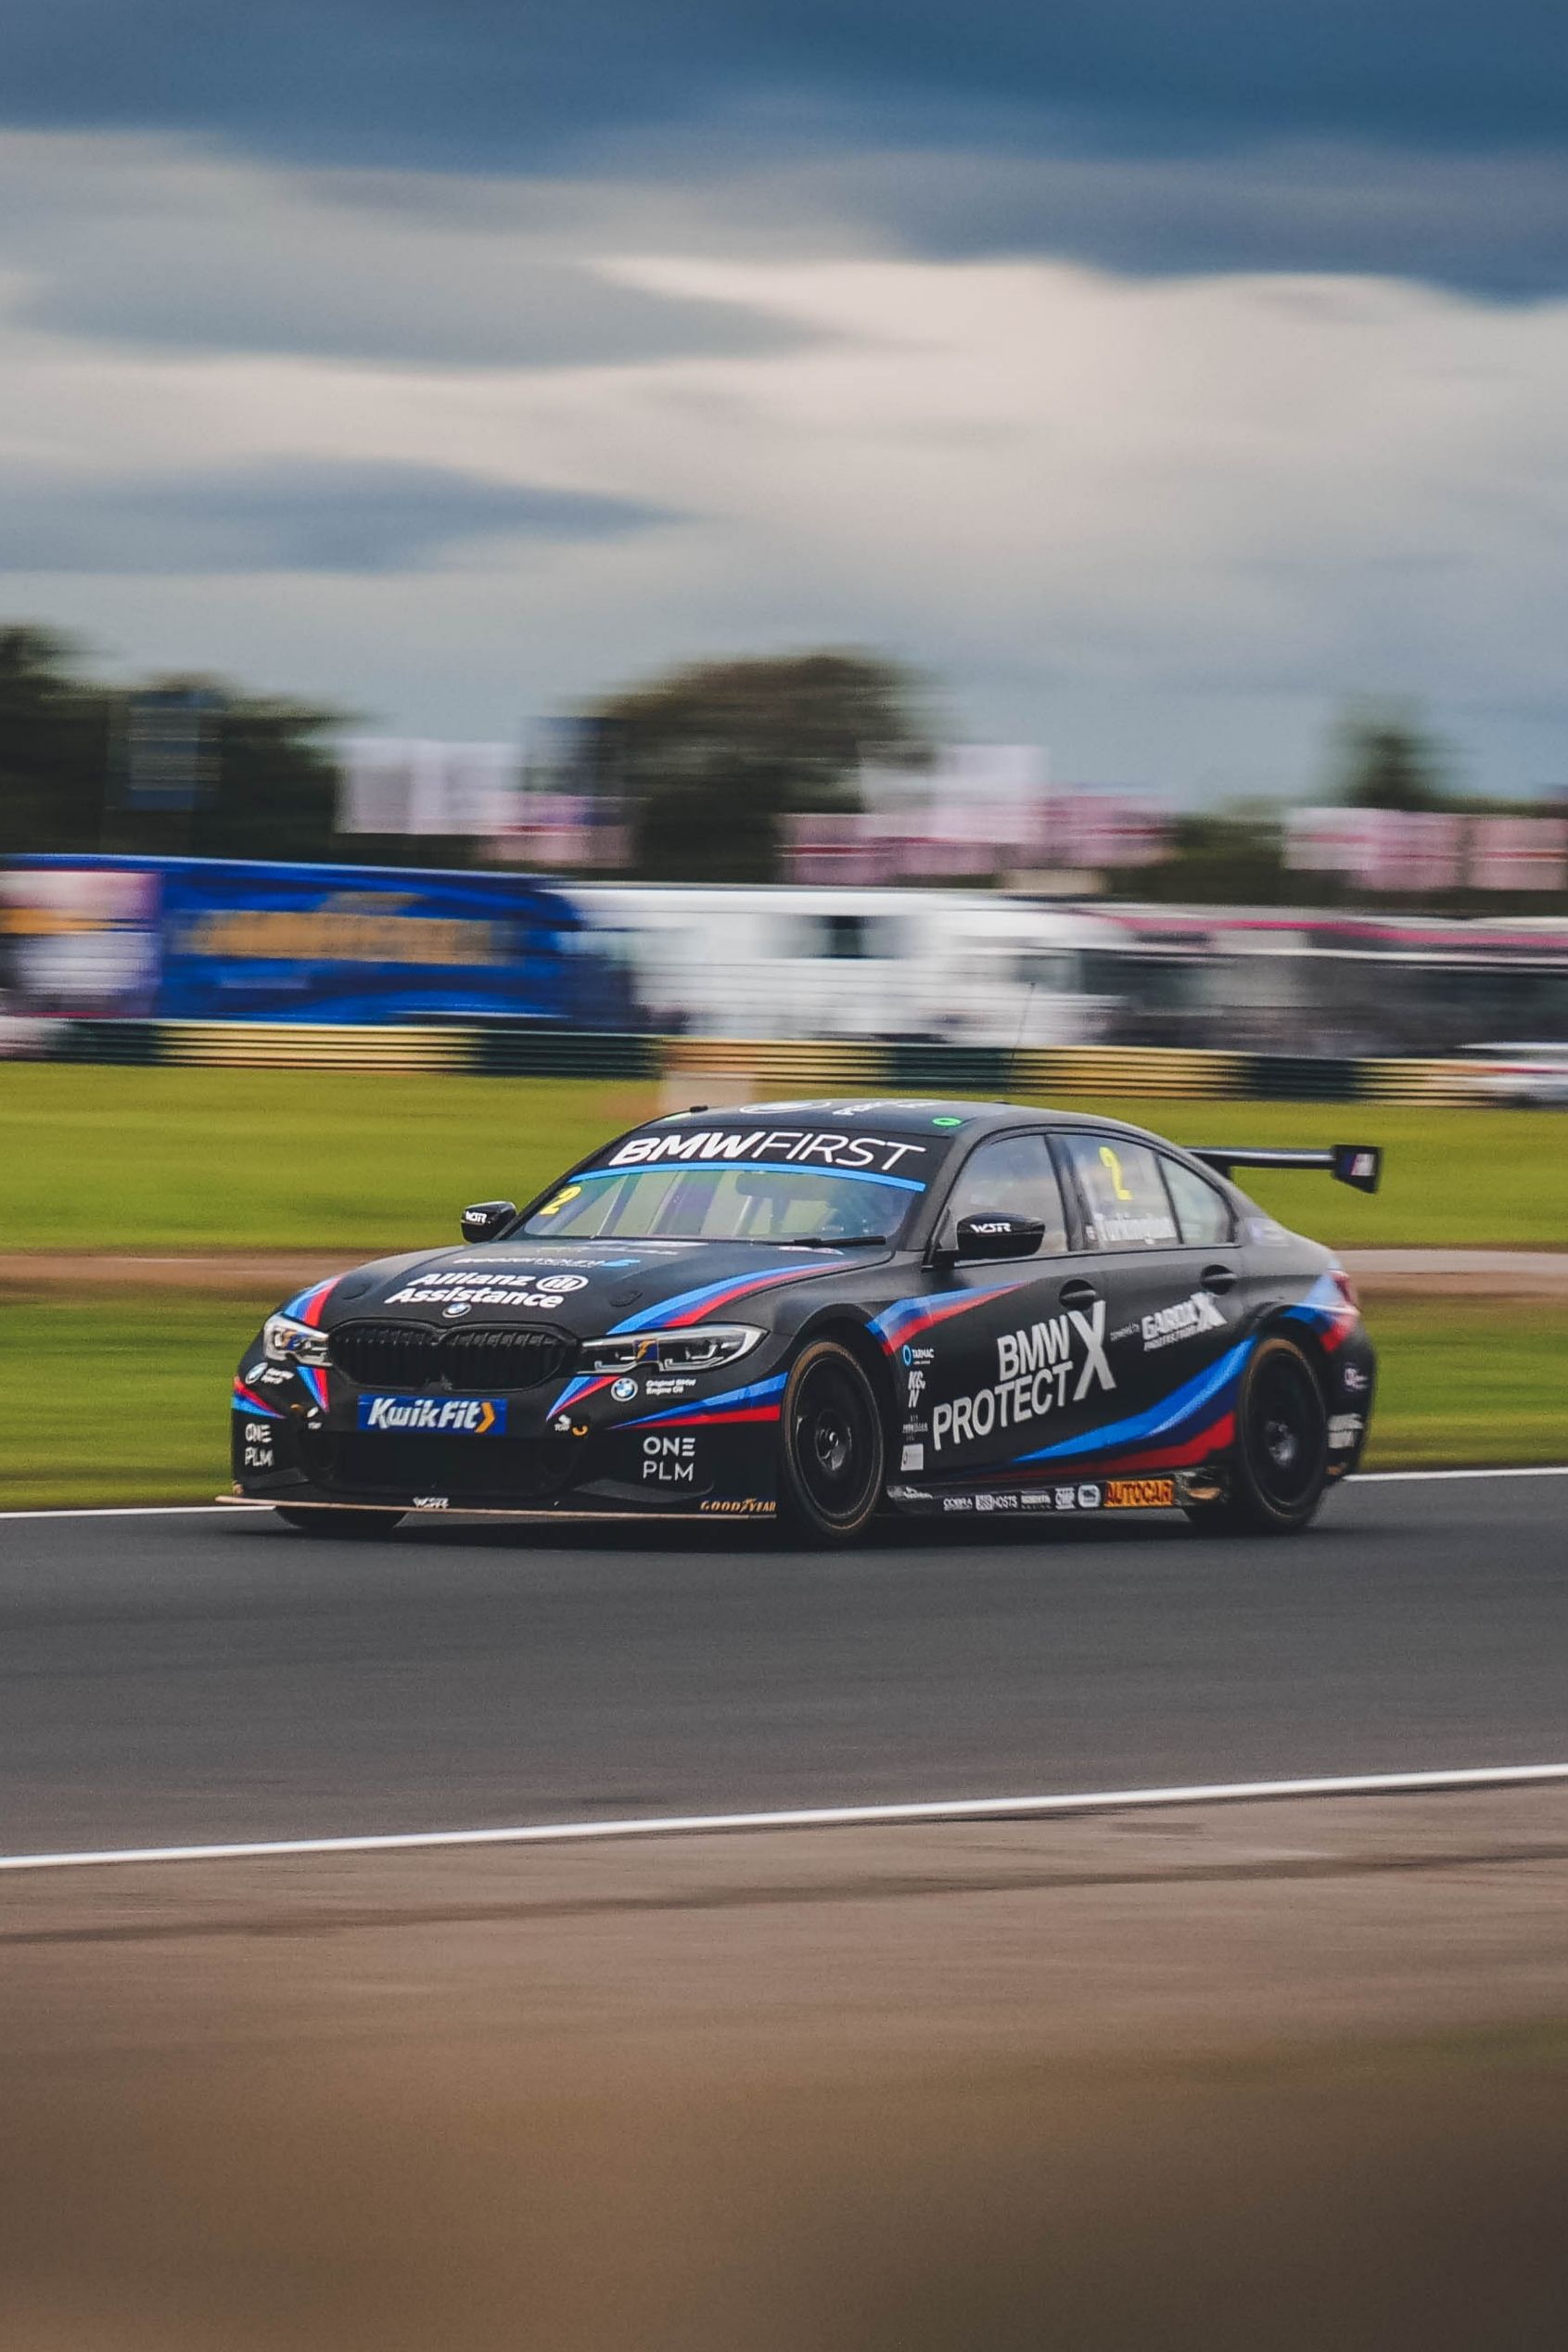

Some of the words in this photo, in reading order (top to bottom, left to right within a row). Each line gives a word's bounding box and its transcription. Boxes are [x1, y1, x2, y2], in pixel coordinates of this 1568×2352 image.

[538, 1185, 581, 1216] 2
[970, 1222, 1011, 1233] WSR
[407, 1272, 537, 1287] Allianz
[383, 1286, 565, 1309] Assistance
[997, 1314, 1070, 1382] BMW
[1067, 1299, 1116, 1401] X
[933, 1361, 1074, 1451] PROTECT
[245, 1423, 272, 1443] ONE
[245, 1447, 274, 1467] PLM
[643, 1437, 695, 1457] ONE
[643, 1461, 695, 1482] PLM
